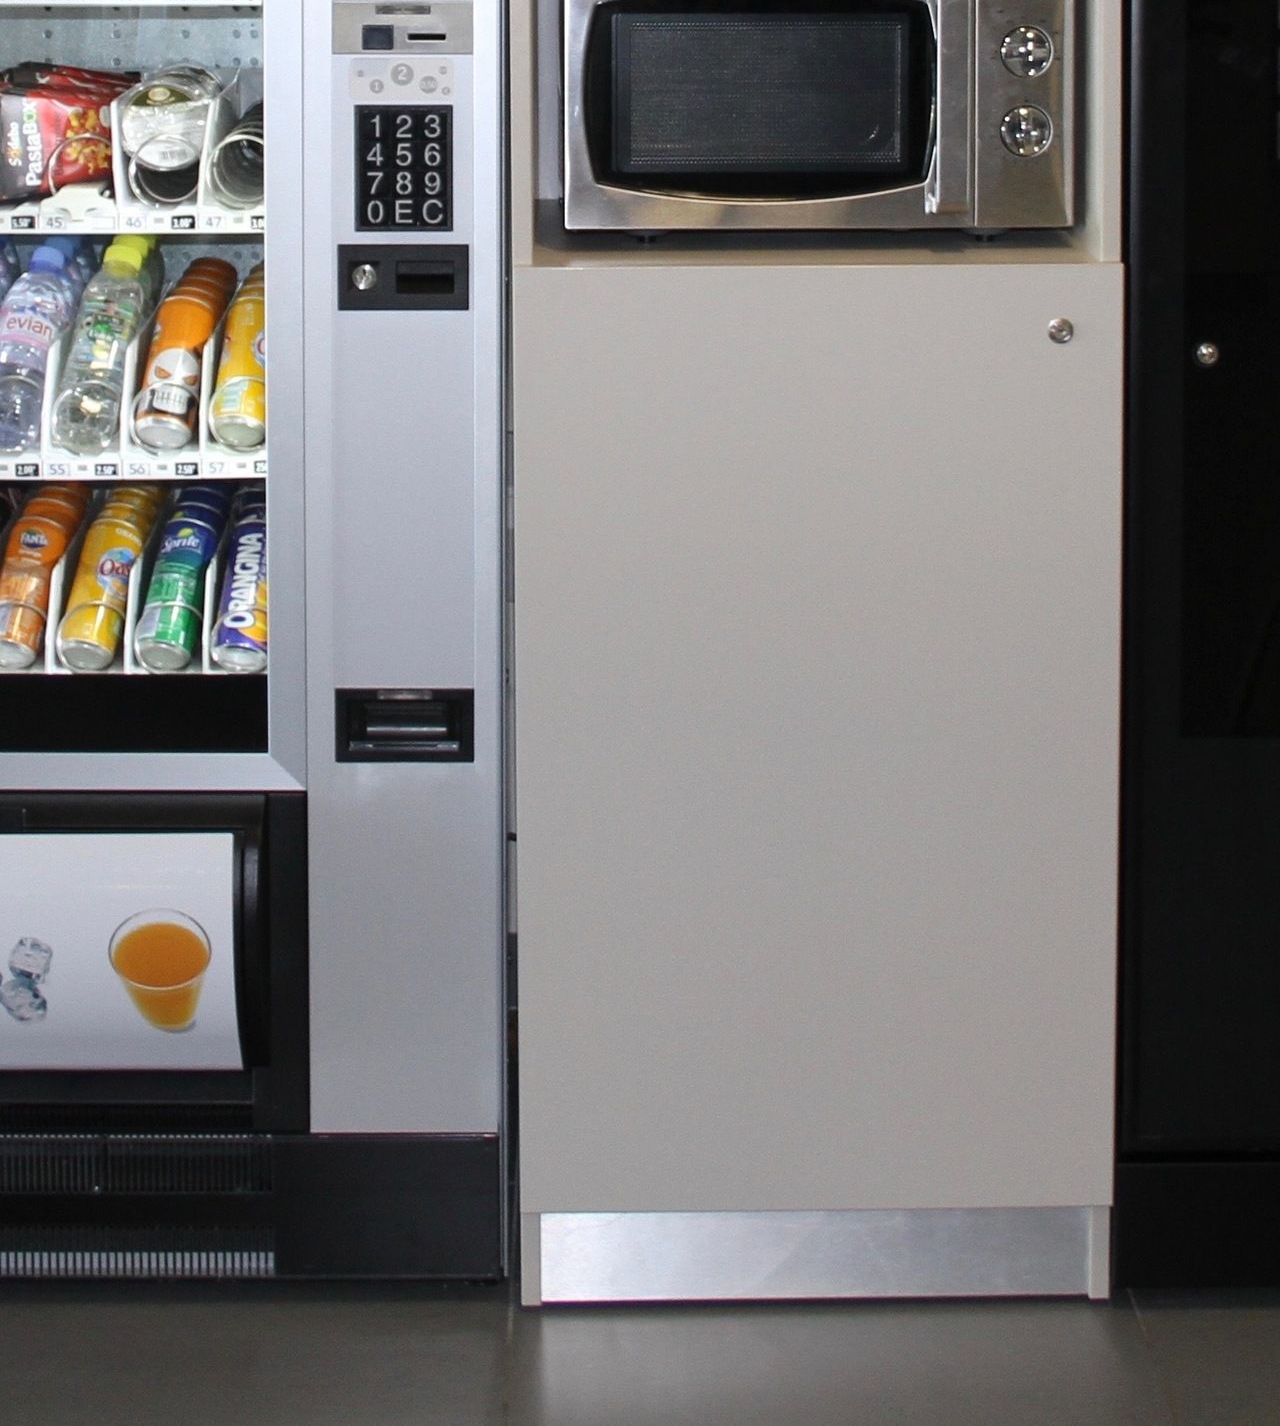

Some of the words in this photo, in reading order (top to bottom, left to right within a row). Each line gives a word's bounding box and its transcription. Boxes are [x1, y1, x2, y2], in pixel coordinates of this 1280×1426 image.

[397, 65, 408, 81] 2
[370, 115, 381, 138] 1
[395, 115, 412, 138] 2
[423, 115, 441, 138] 3
[367, 143, 384, 167] 4
[395, 143, 412, 167] 5
[423, 143, 441, 167] 6
[367, 172, 384, 195] 7
[395, 172, 412, 195] 8
[423, 172, 441, 195] 9
[395, 199, 413, 224] E
[422, 199, 444, 224] C
[46, 217, 62, 229] 45
[126, 217, 142, 229] 46
[205, 216, 221, 228] 47
[6, 316, 53, 337] evian
[49, 463, 66, 474] 55
[129, 463, 145, 475] 56
[208, 462, 225, 473] 57
[161, 534, 201, 551] Sprite
[223, 533, 263, 629] ORANGINA
